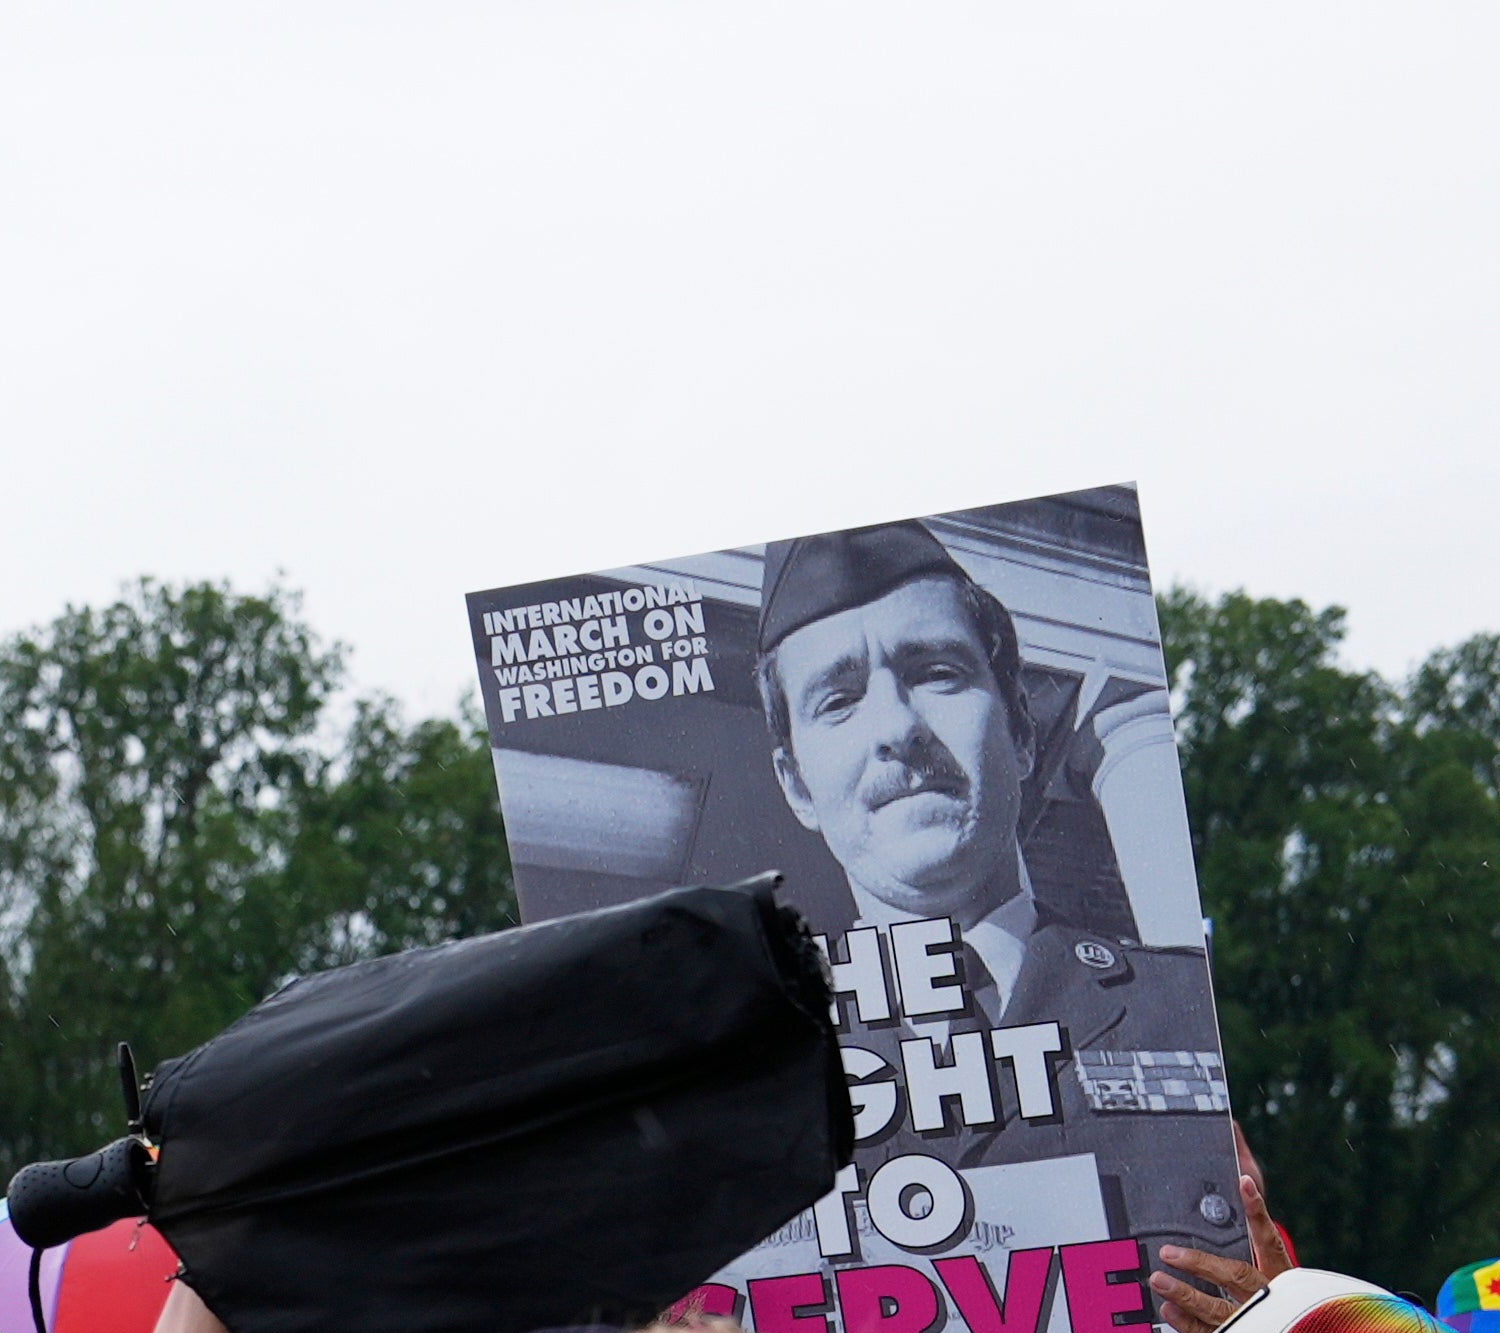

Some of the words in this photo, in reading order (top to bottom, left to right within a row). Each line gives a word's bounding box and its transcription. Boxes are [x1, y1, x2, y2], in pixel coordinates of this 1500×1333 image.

[482, 579, 704, 636] INTERNATIONAL
[491, 614, 630, 667] MARCH
[643, 602, 706, 641] ON
[494, 644, 654, 687] WASHINGTON
[661, 636, 709, 661] FOR
[498, 657, 716, 724] FREEDOM
[813, 916, 966, 1026] HE
[839, 1020, 1064, 1142] GHT
[813, 1153, 968, 1258] TO
